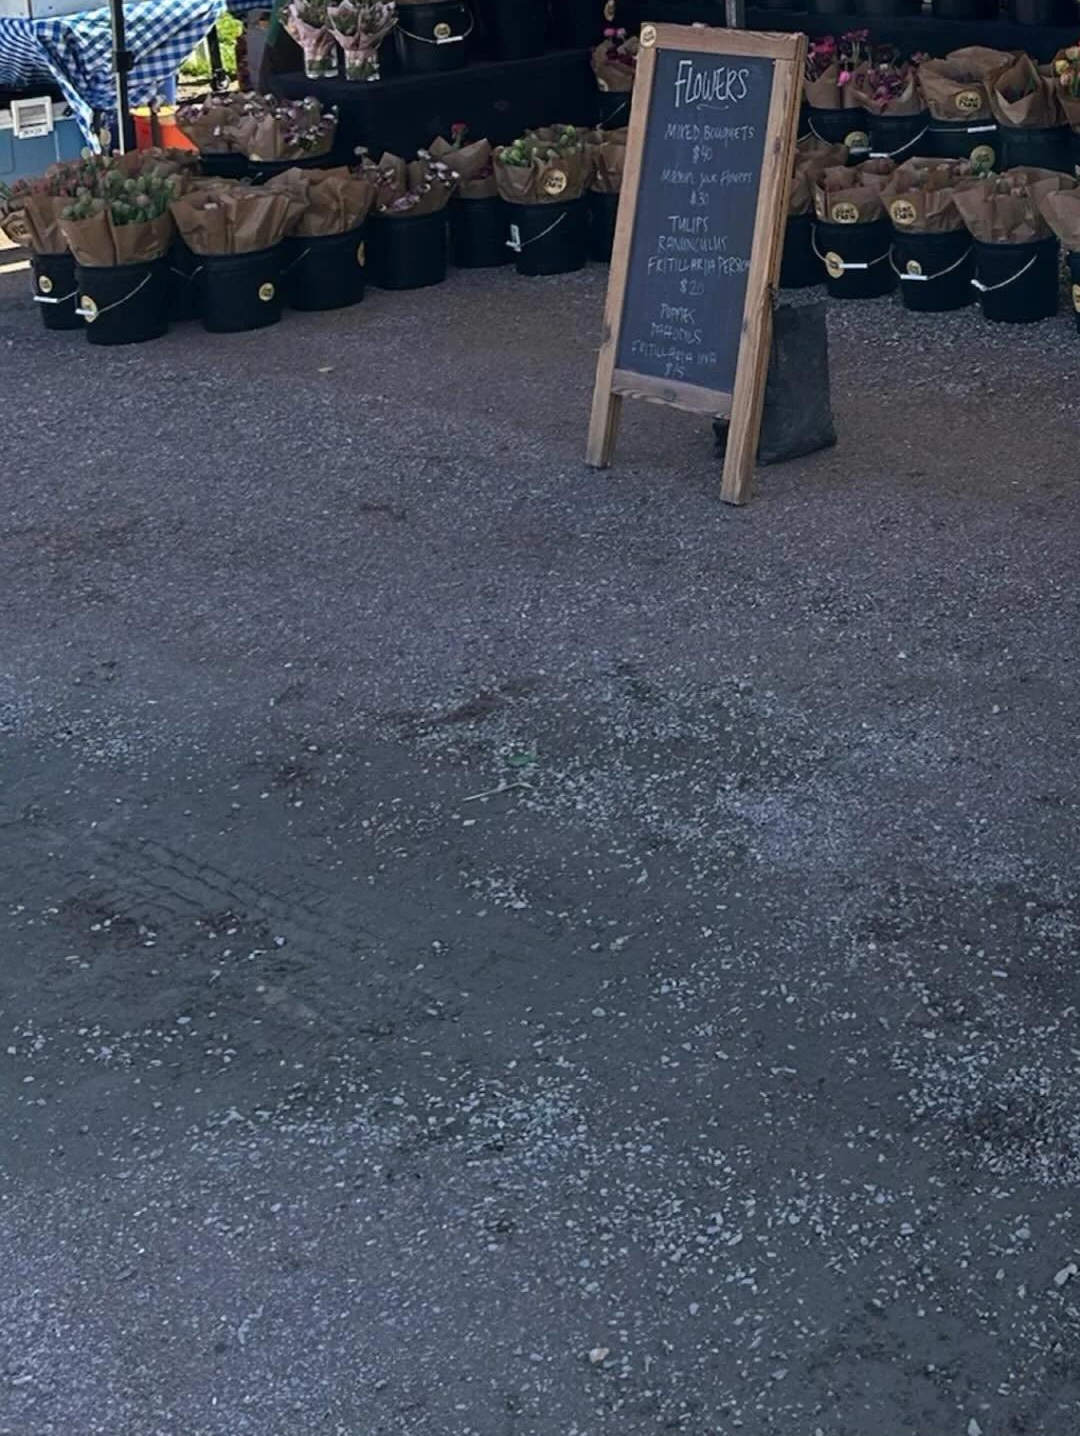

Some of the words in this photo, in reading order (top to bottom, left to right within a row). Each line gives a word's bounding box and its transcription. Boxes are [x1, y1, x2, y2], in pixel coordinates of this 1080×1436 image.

[674, 59, 749, 108] FLOWERS
[664, 123, 700, 141] MIXED
[703, 123, 756, 148] BOUQUETS
[667, 215, 709, 233] TULIPS
